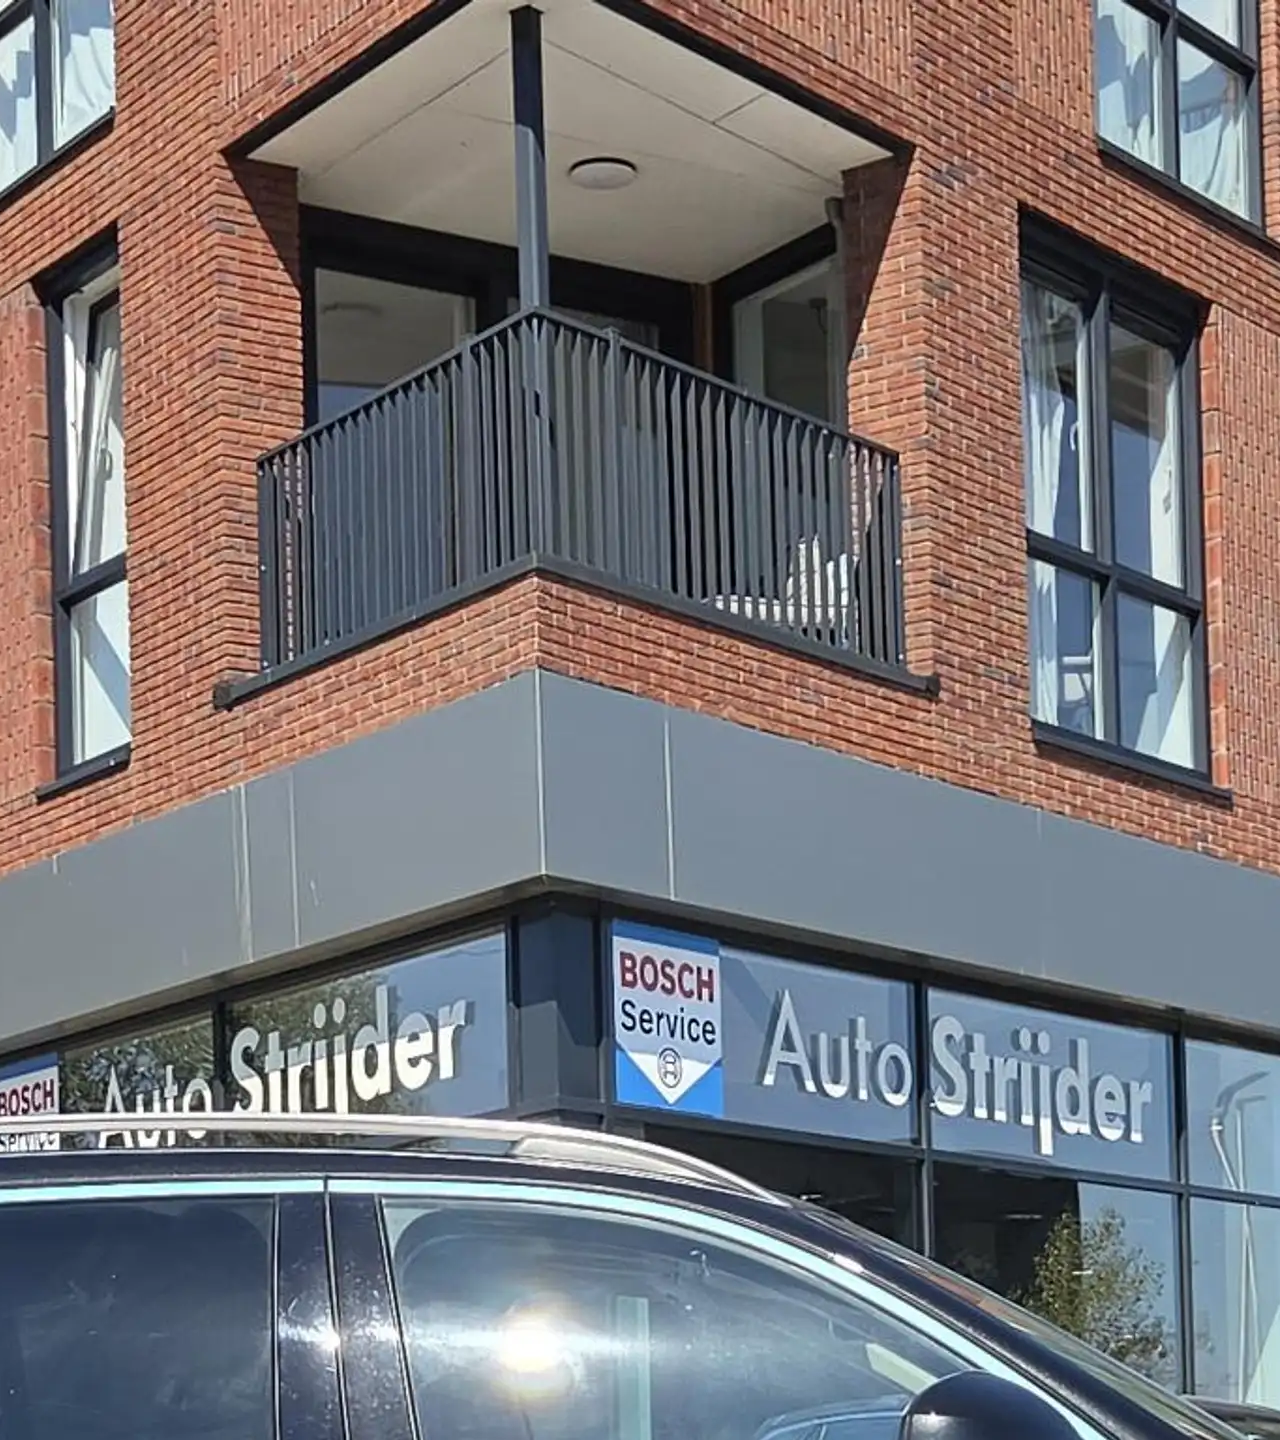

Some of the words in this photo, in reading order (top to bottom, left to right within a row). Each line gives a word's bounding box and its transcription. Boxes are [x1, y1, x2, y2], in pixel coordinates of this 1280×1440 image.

[619, 951, 715, 1003] BOSCH
[620, 1000, 716, 1046] Service
[98, 1064, 213, 1149] Auto
[230, 984, 468, 1114] Strijder
[761, 989, 912, 1107] Auto
[930, 1015, 1152, 1155] Strijder
